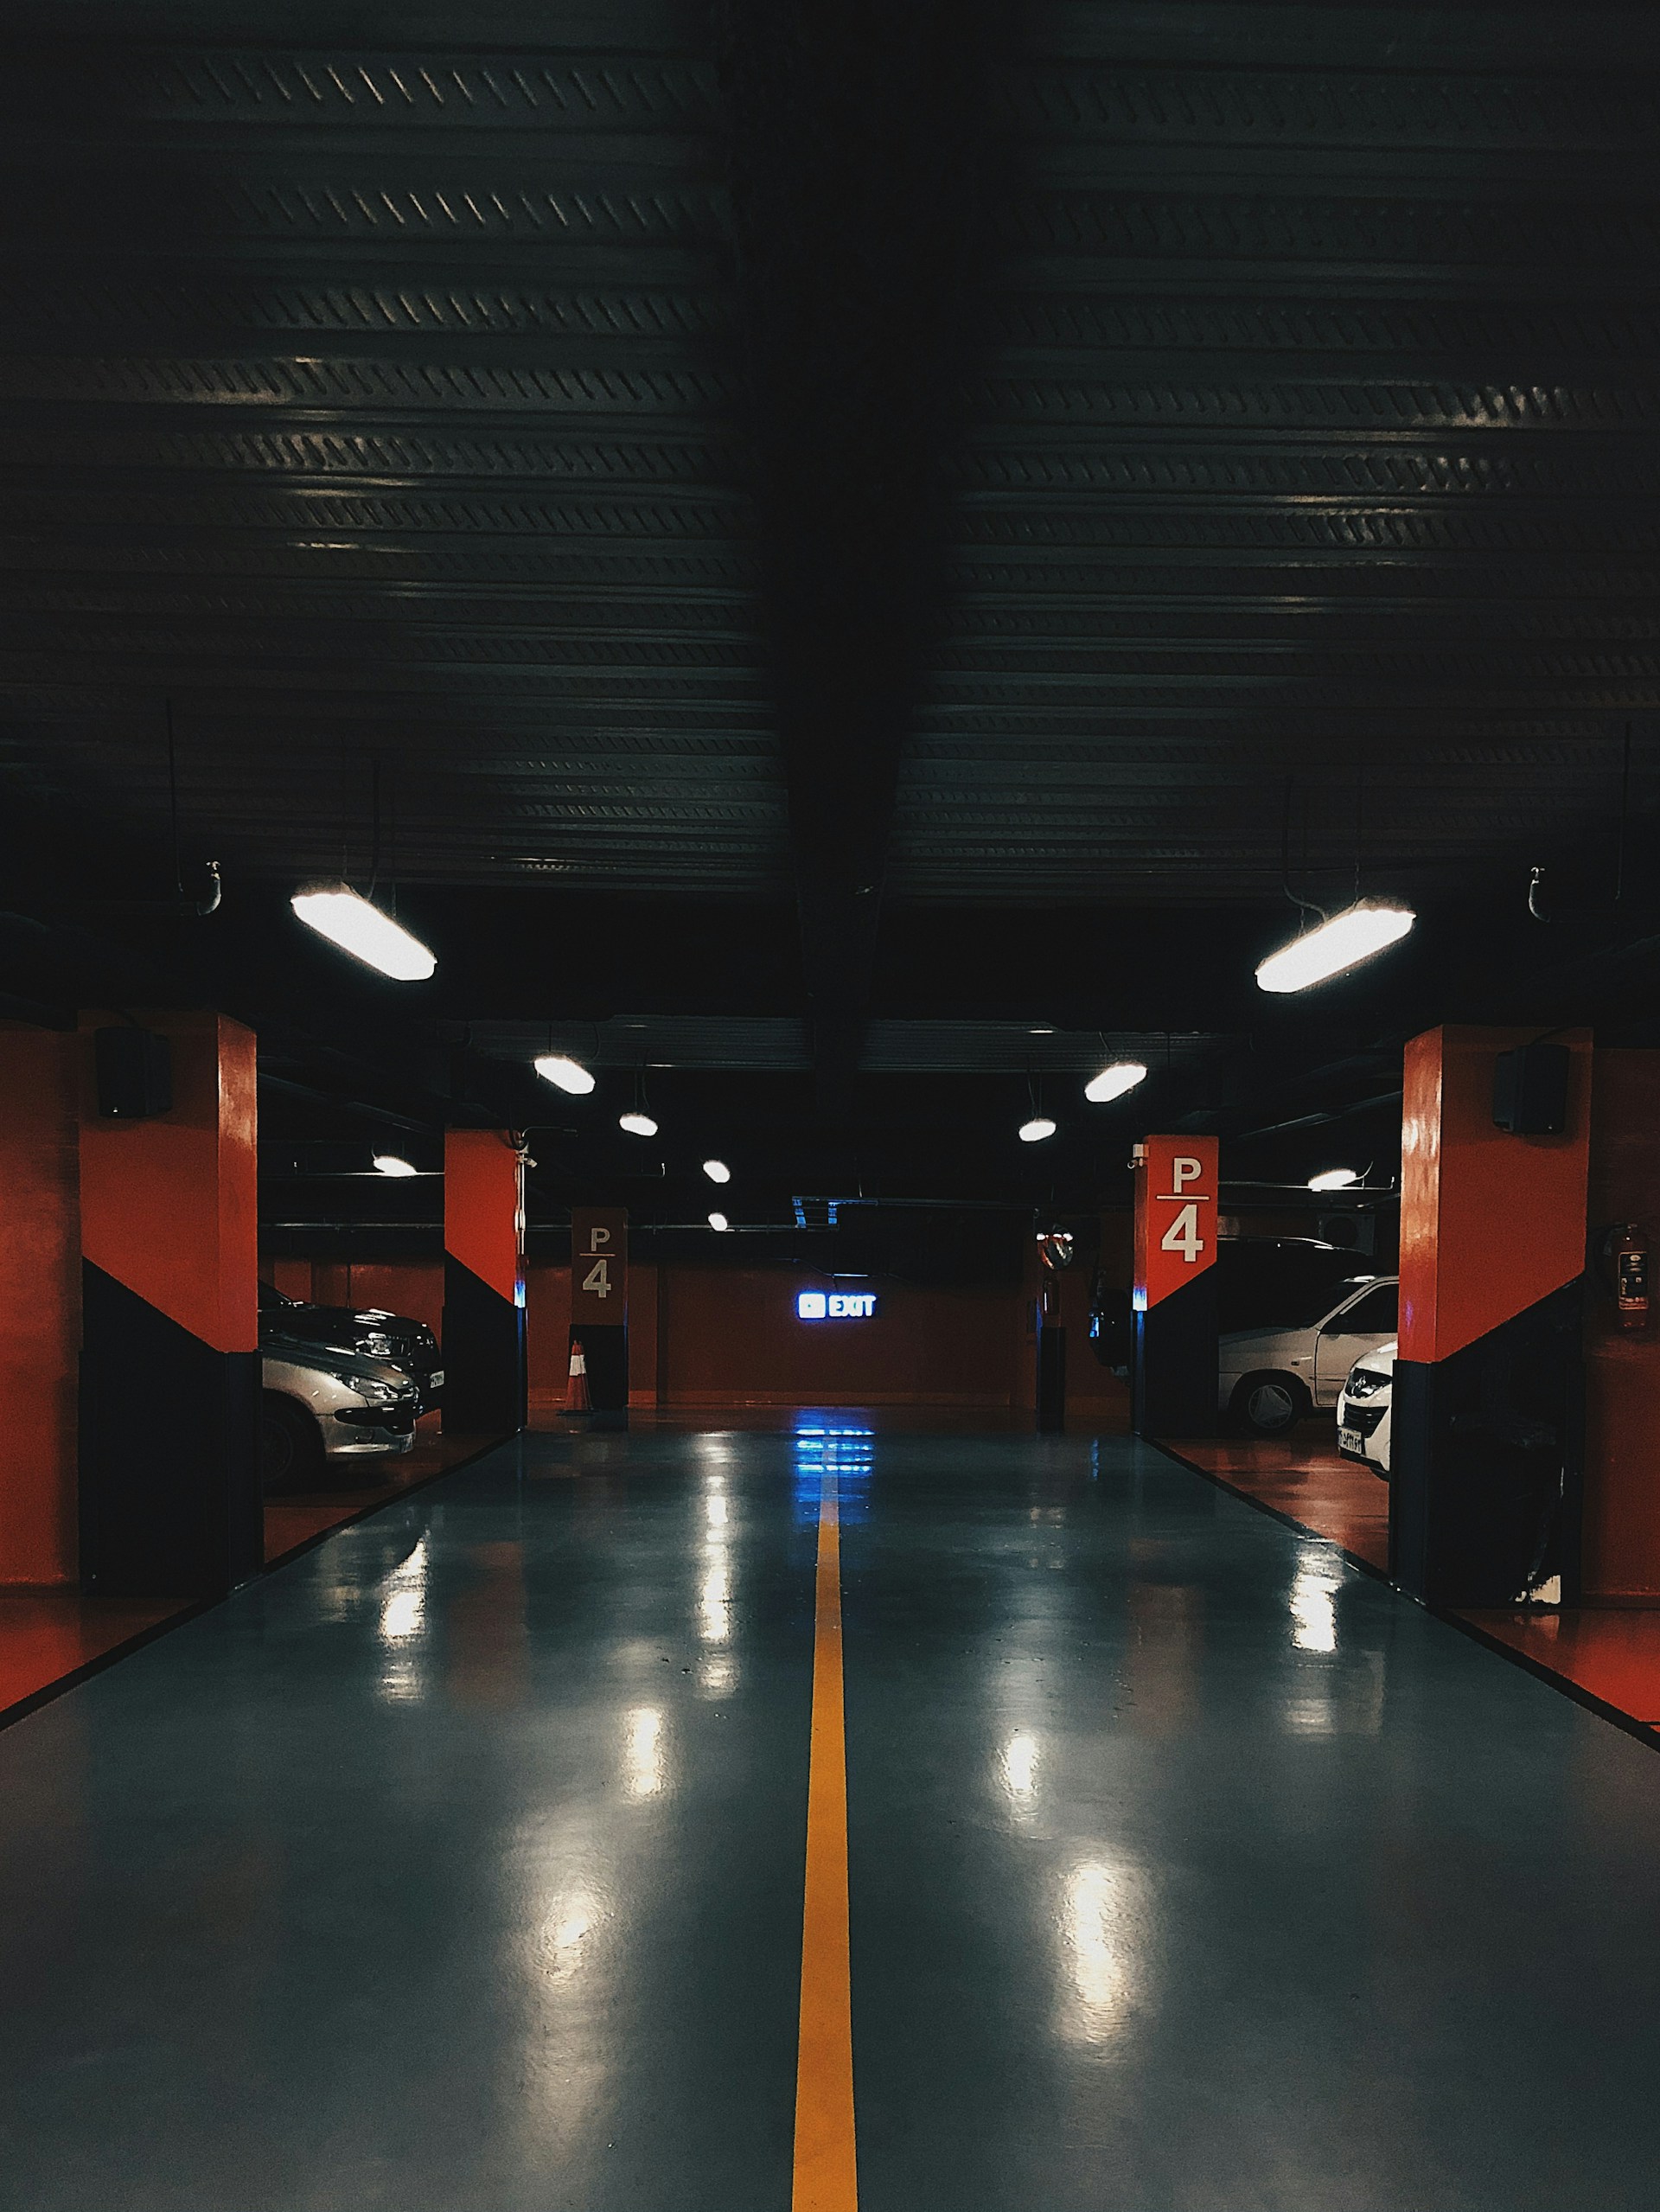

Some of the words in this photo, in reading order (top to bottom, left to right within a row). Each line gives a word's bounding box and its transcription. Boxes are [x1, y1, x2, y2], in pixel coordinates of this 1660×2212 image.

[1173, 1157, 1202, 1193] P
[591, 1228, 610, 1252] P
[1161, 1204, 1204, 1263] 4
[582, 1259, 612, 1298] 4
[828, 1295, 876, 1317] EXIT
